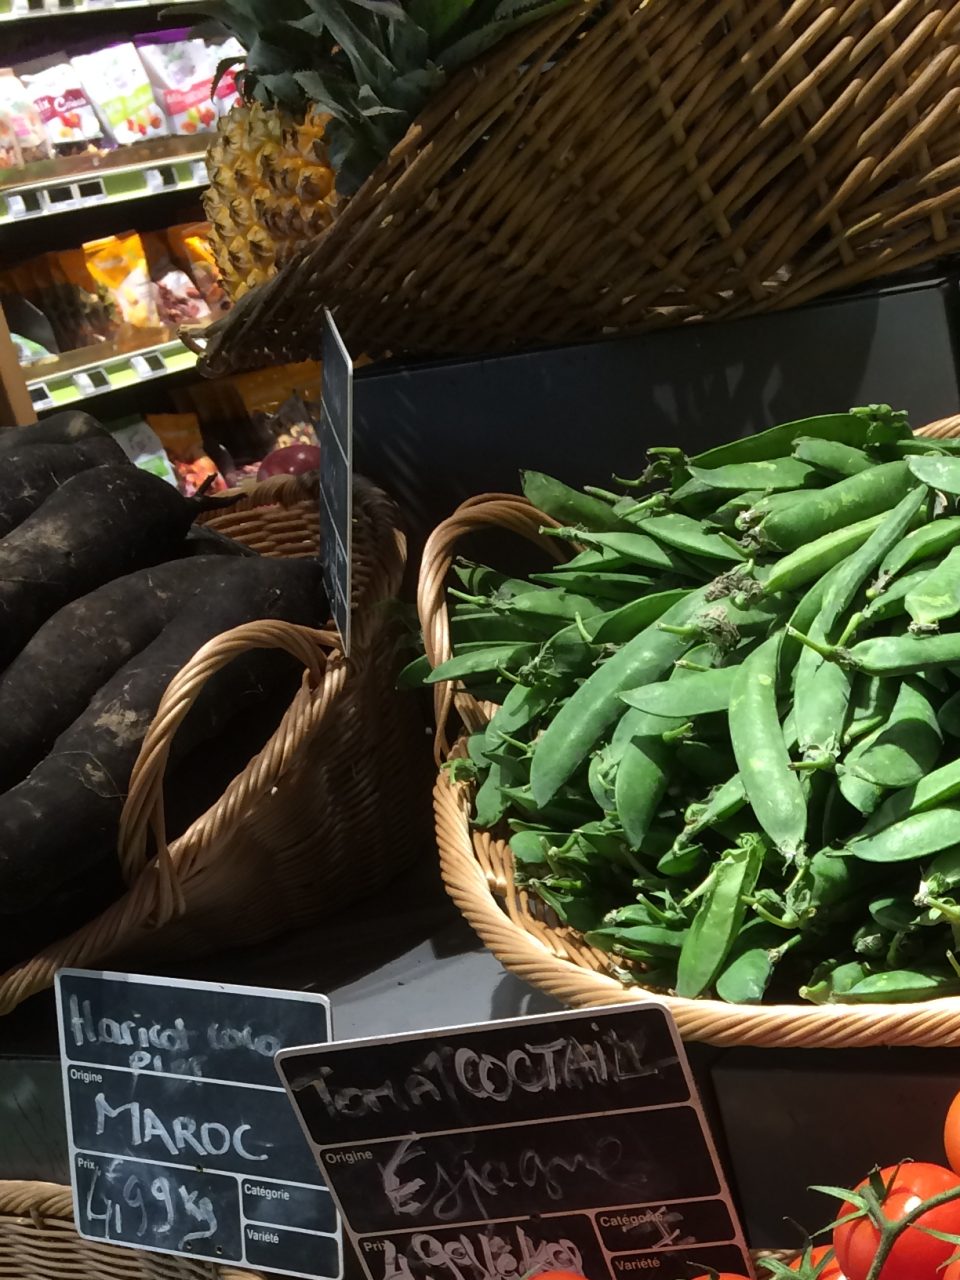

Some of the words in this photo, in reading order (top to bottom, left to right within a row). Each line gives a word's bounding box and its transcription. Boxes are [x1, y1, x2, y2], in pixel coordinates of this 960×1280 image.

[69, 1068, 104, 1084] Origine
[94, 1092, 268, 1162] MAROC
[76, 1157, 96, 1171] Prix
[325, 1149, 374, 1166] Origine
[244, 1183, 291, 1202] Catégorie
[246, 1229, 281, 1246] Variété
[615, 1257, 662, 1271] Variété
